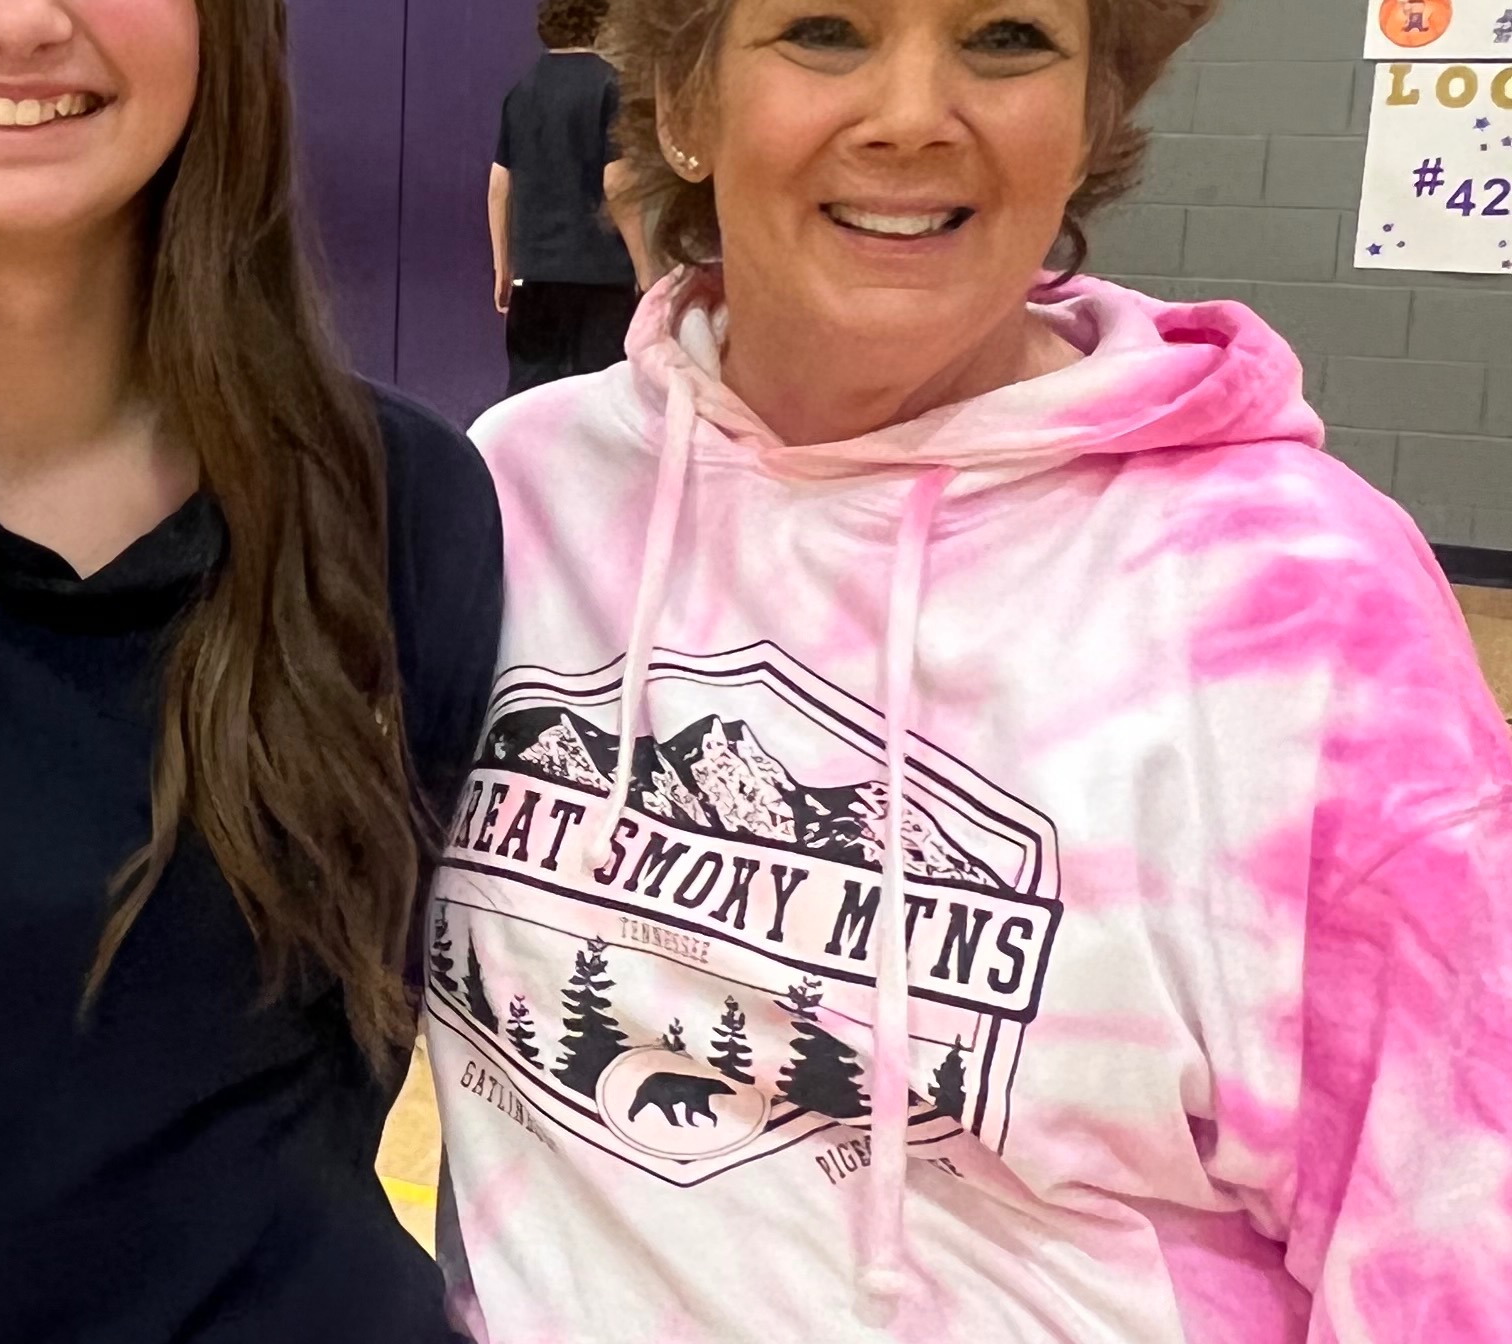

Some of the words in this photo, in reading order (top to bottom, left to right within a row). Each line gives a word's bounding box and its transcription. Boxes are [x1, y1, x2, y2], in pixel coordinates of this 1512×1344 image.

[1413, 157, 1511, 216] #42
[454, 781, 585, 872] REAT
[593, 817, 809, 943] SMOKY
[825, 880, 1034, 996] MTNS
